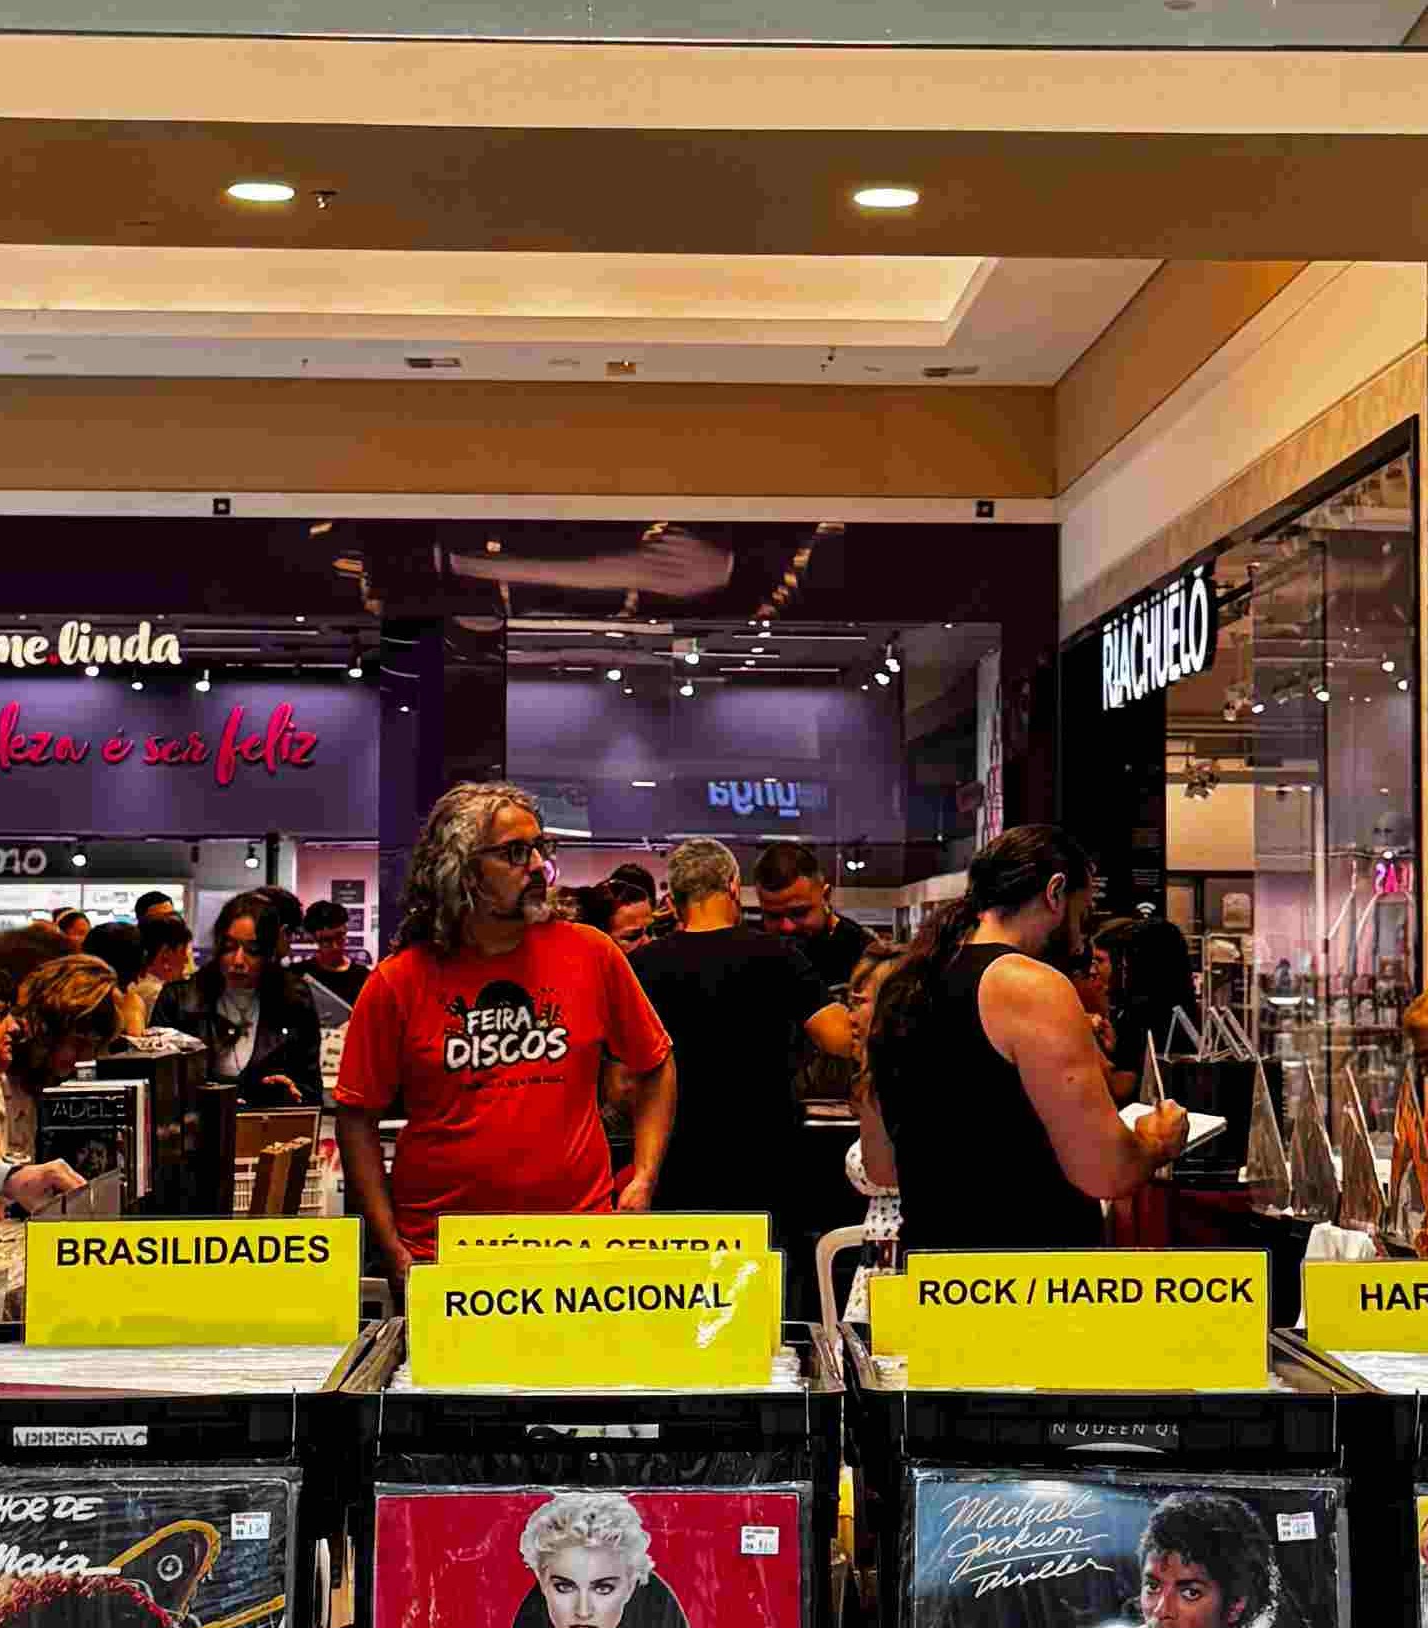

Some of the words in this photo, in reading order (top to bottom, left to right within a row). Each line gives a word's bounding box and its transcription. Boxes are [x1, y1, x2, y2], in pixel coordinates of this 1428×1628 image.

[1103, 565, 1209, 711] RIACHUELO
[141, 730, 209, 767] ser
[213, 701, 318, 787] feliz
[466, 1005, 532, 1035] FEIRA
[445, 1027, 568, 1069] DISCOS
[57, 1235, 330, 1268] BRASILIDADES
[445, 1287, 544, 1318] ROCK
[555, 1281, 734, 1314] NACIONAL
[918, 1278, 1017, 1307] ROCK
[1026, 1278, 1036, 1306] /
[1046, 1277, 1144, 1306] HARD
[1155, 1275, 1254, 1305] ROCK
[52, 1495, 105, 1522] DE
[941, 1490, 1105, 1539] Michael
[947, 1526, 1109, 1585] Jackson
[970, 1553, 1116, 1598] Thriller
